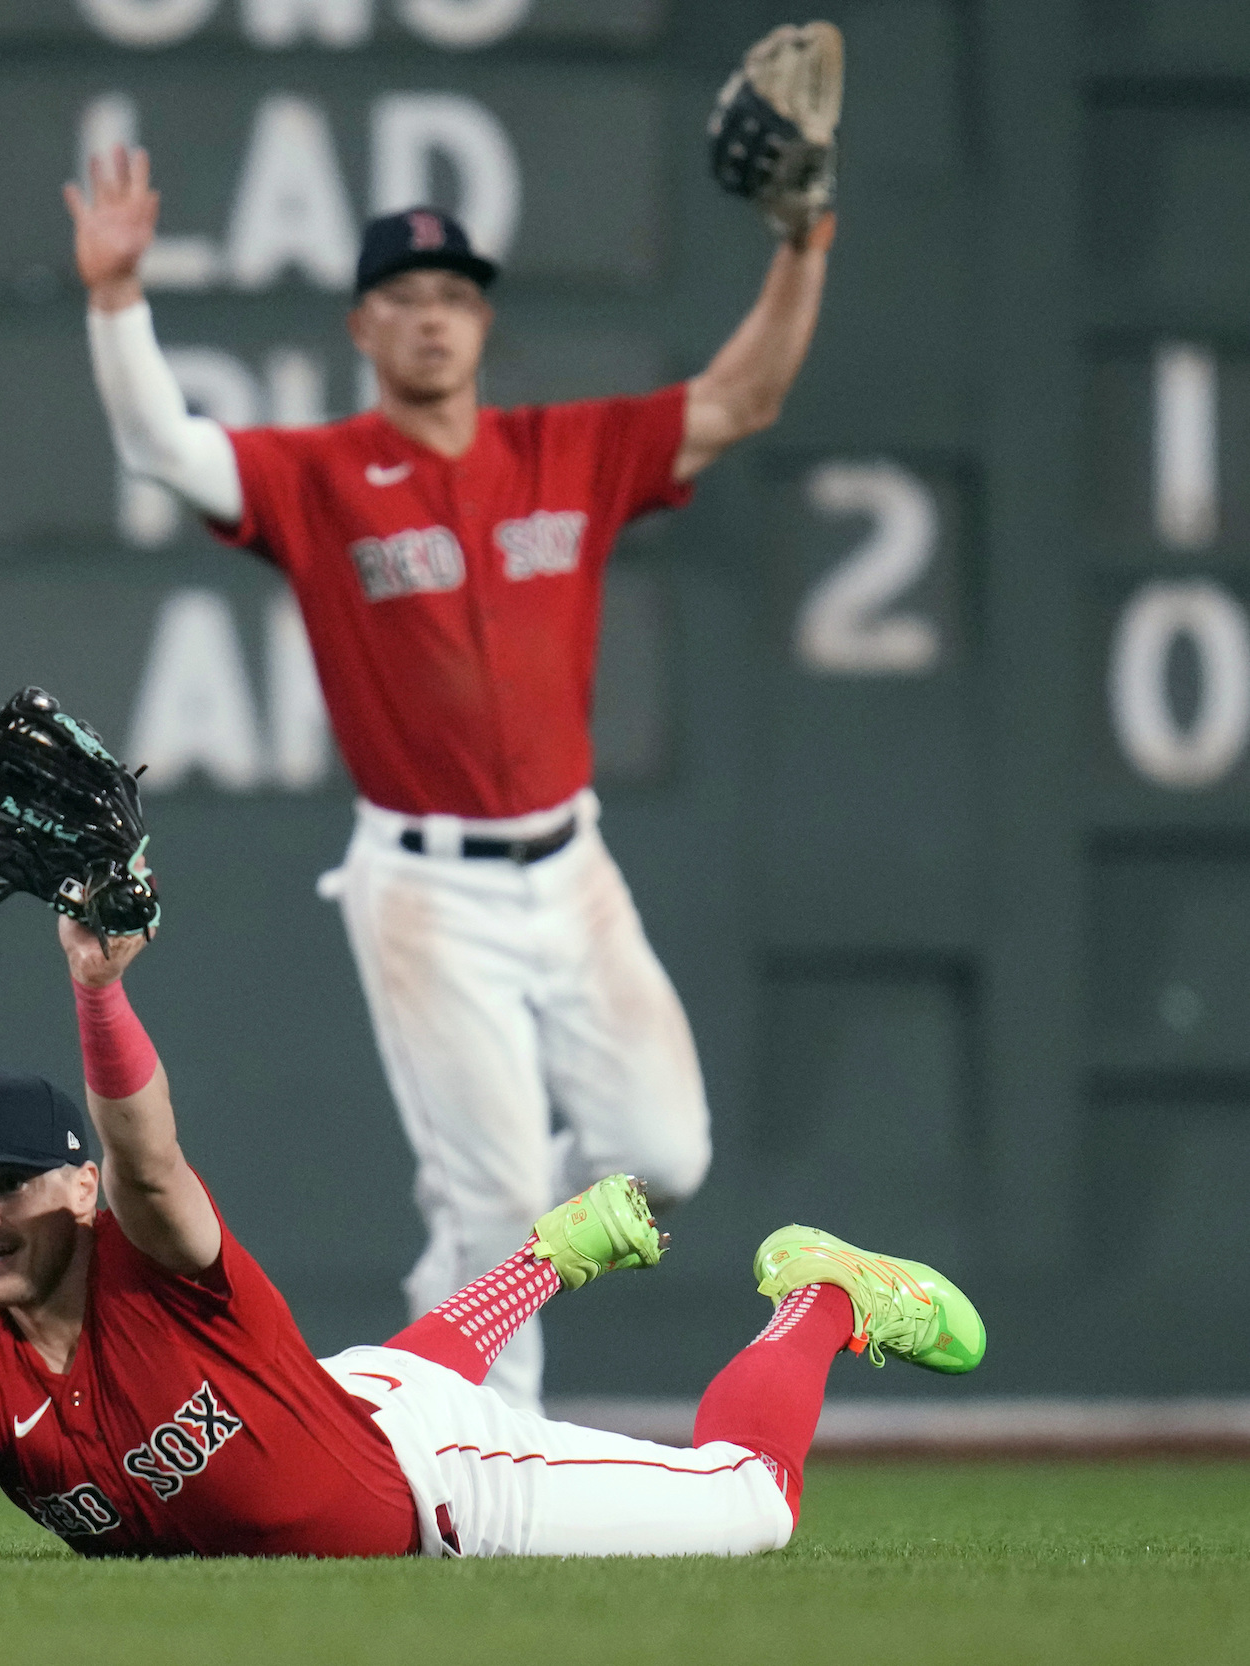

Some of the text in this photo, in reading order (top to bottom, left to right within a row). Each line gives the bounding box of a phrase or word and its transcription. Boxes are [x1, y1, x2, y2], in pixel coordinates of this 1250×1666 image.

[352, 524, 467, 603] RED
[795, 458, 940, 676] 2
[1108, 580, 1250, 790] 0
[123, 1380, 243, 1502] SOX
